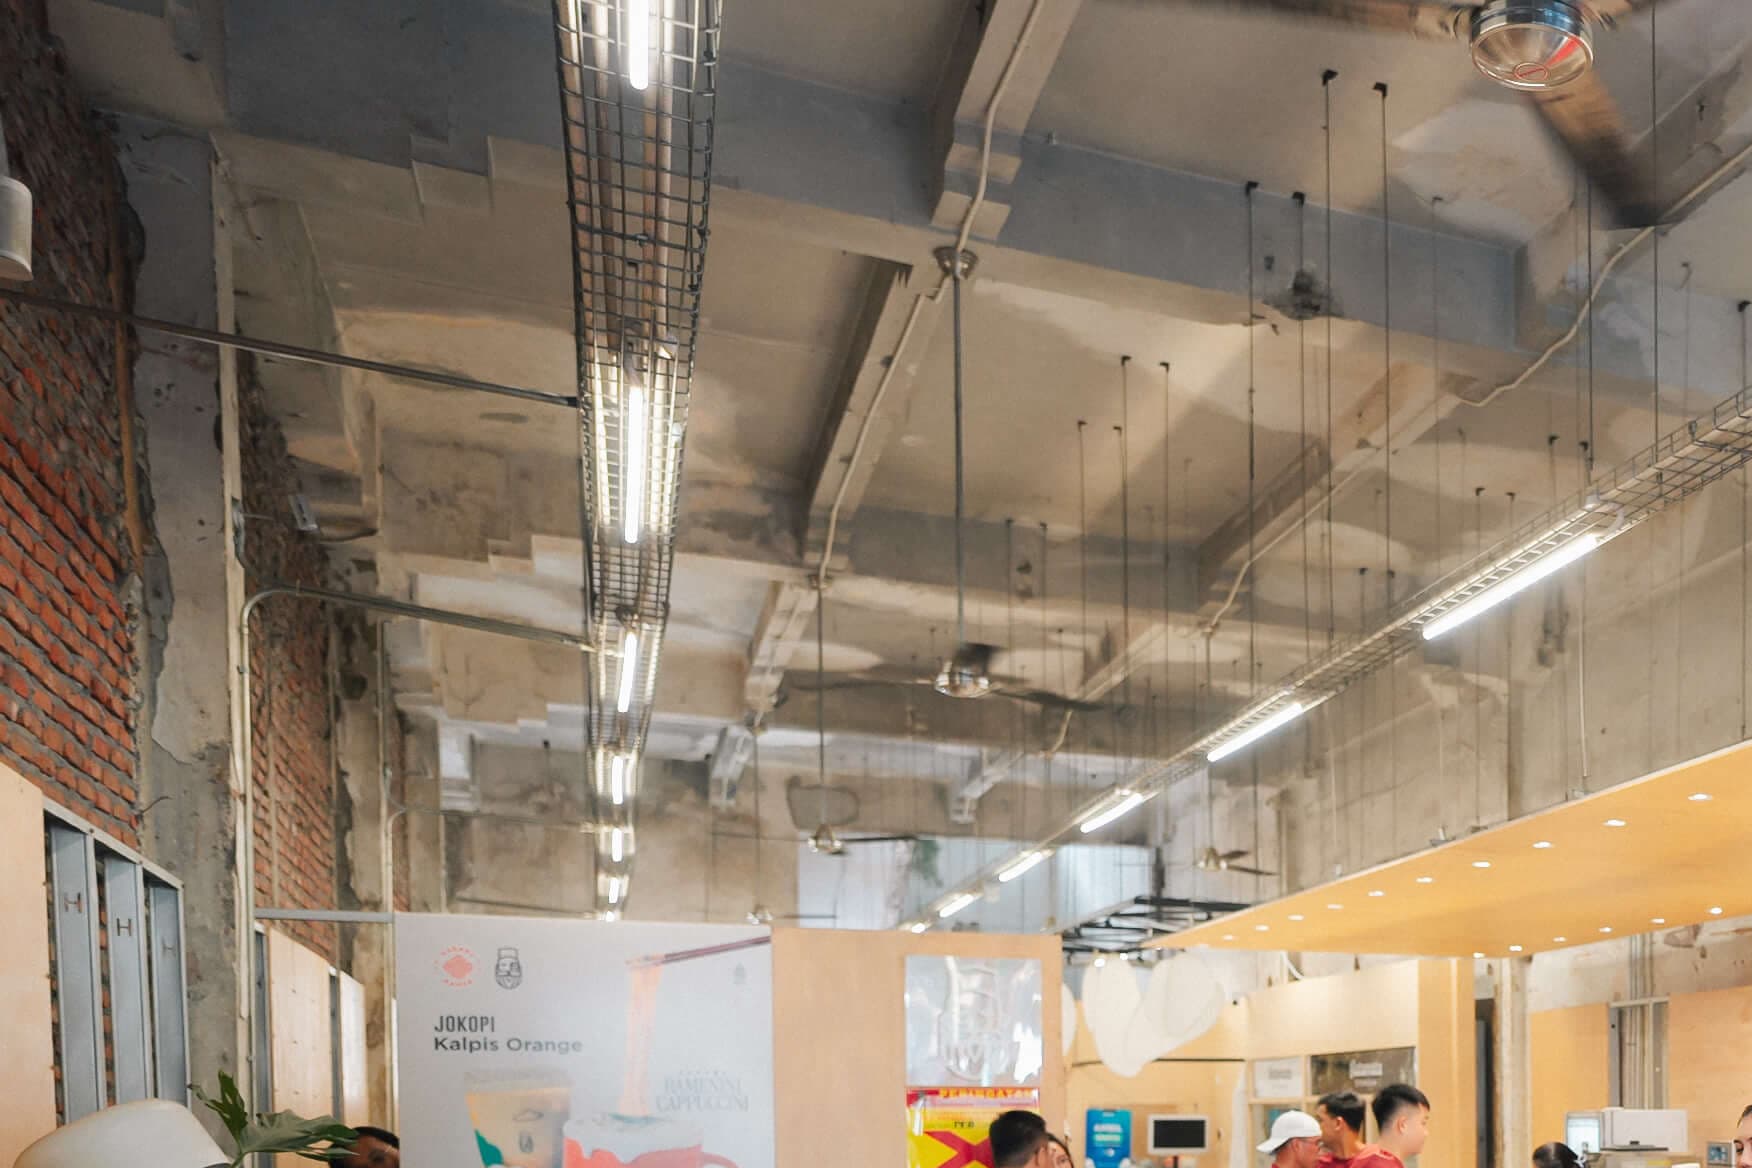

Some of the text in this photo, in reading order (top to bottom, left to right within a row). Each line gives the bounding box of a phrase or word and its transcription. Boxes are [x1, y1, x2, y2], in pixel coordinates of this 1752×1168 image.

[434, 1015, 496, 1033] JOKOPI
[434, 1037, 583, 1055] Kalpis Orange
